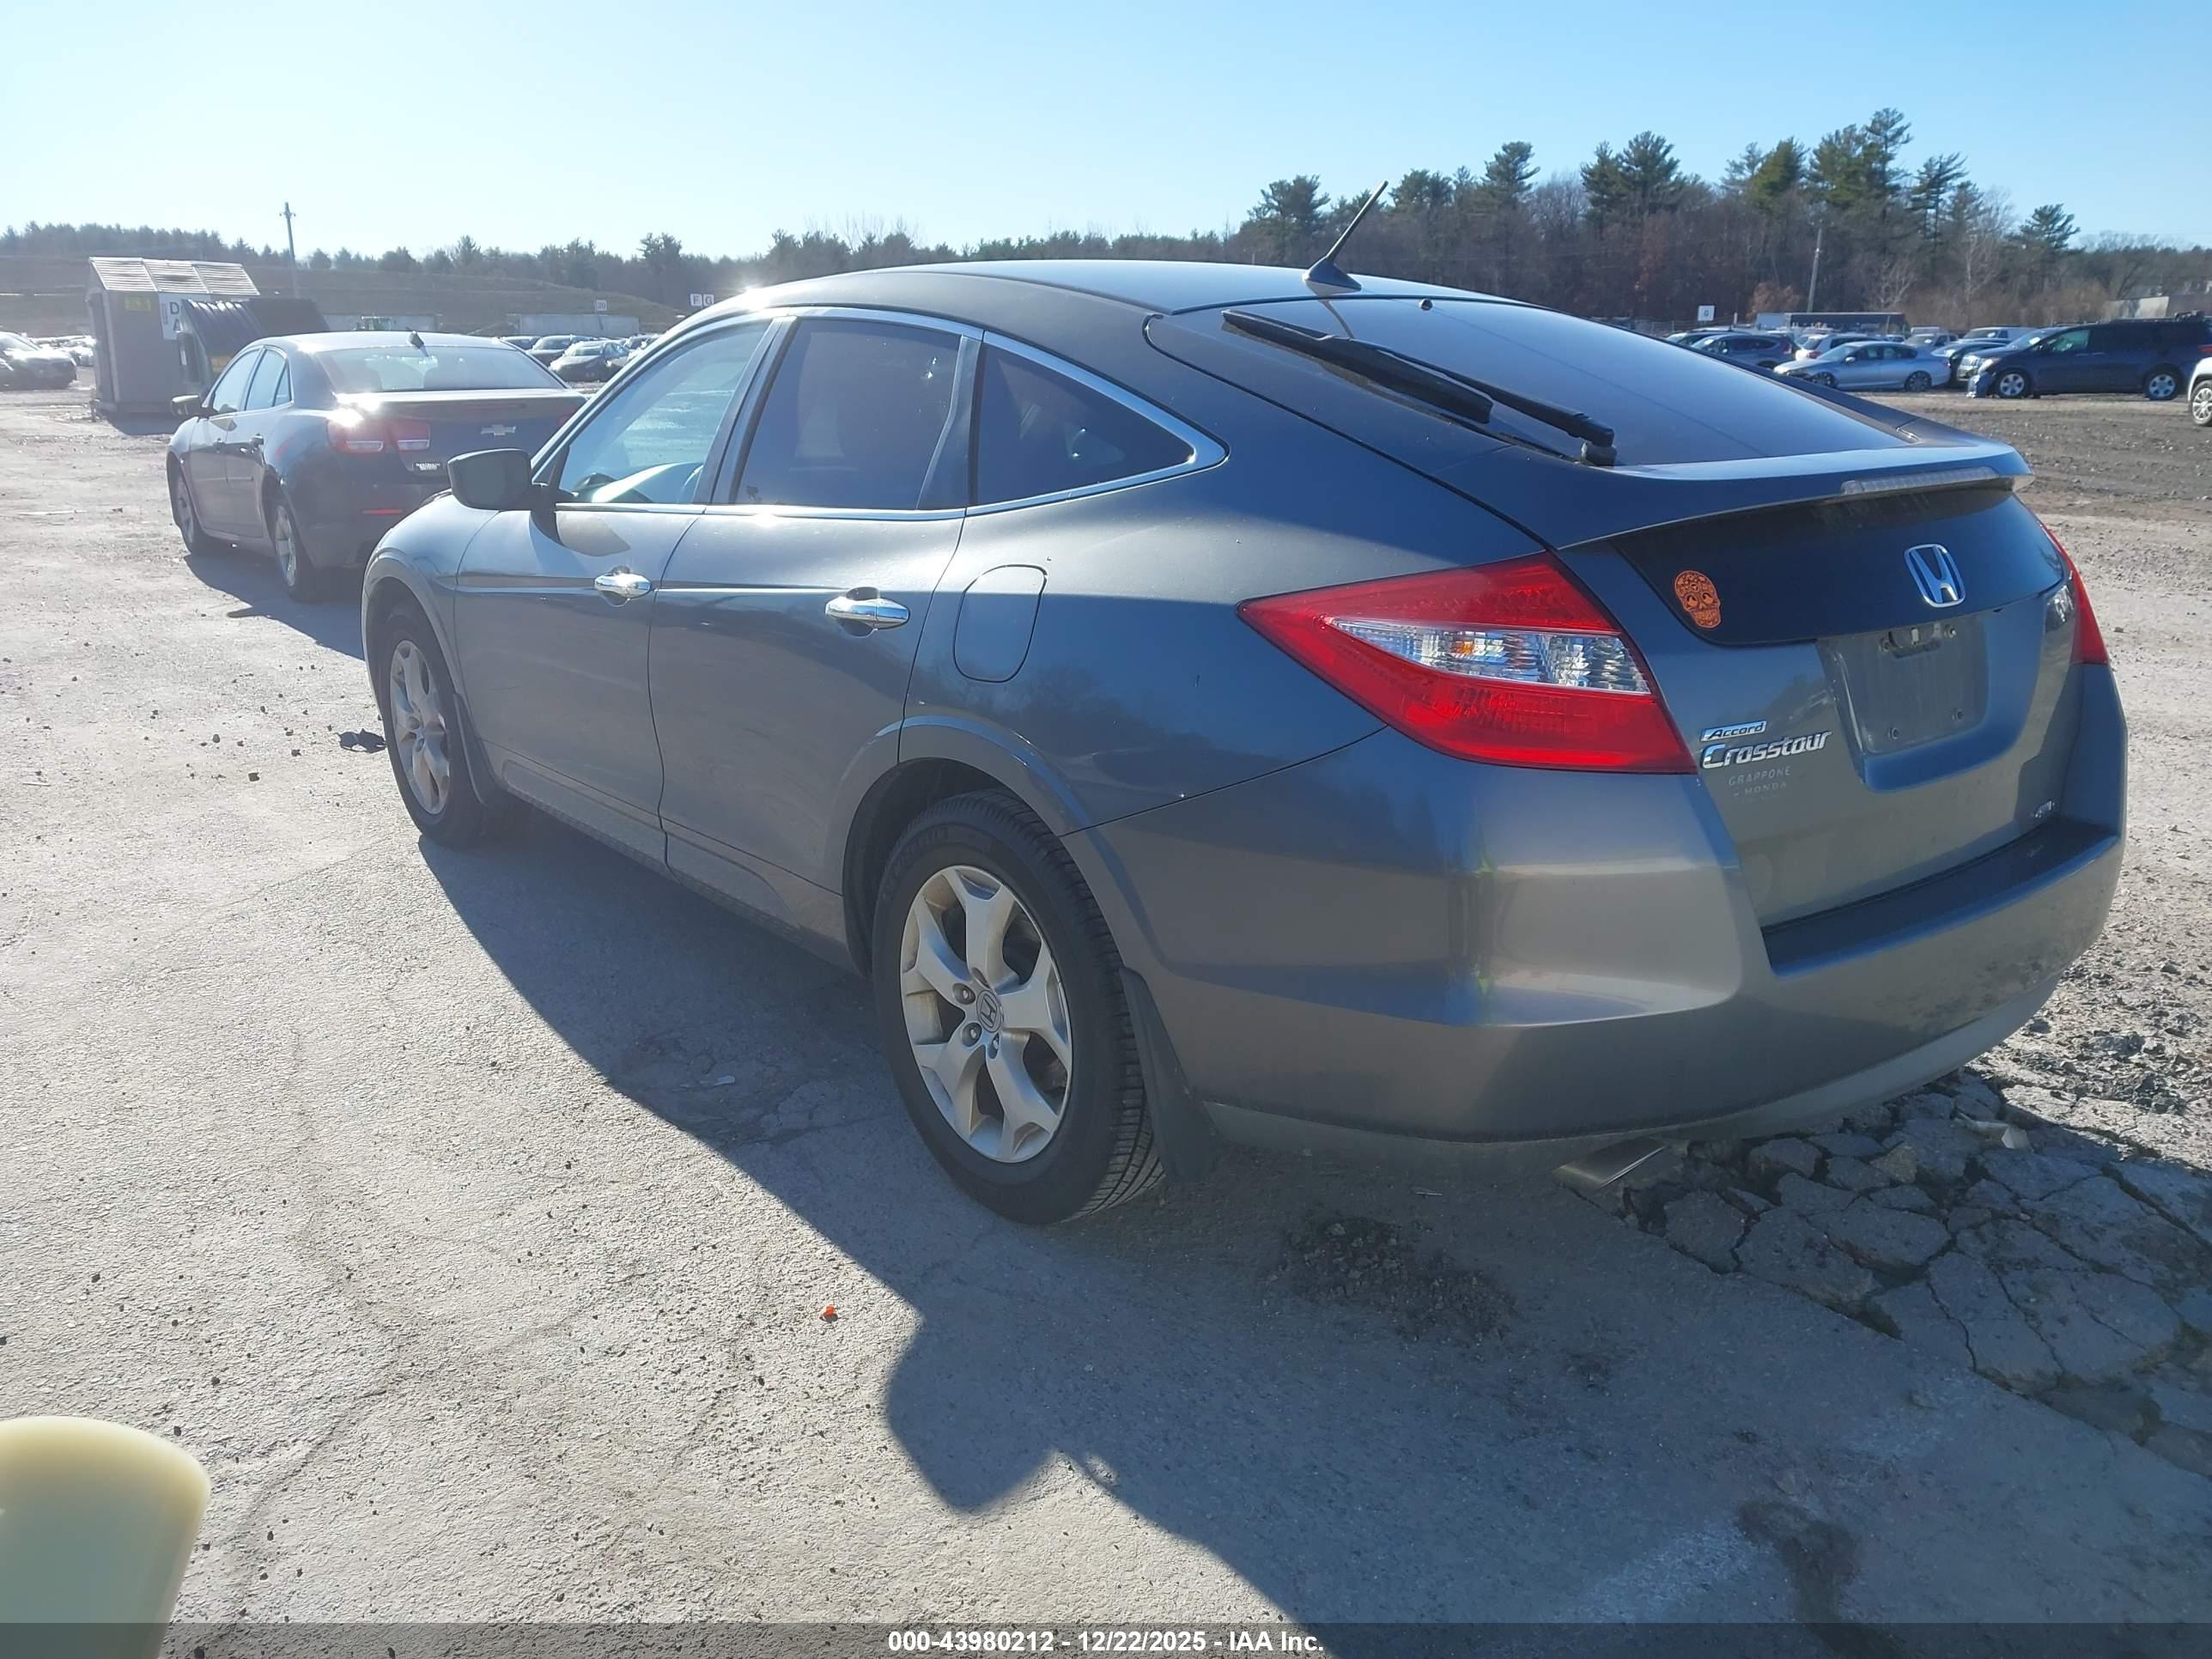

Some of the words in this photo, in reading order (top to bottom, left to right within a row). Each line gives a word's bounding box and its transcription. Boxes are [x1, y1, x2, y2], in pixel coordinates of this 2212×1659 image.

[1707, 721, 1765, 740] Accord
[1702, 732, 1832, 769] Crosstour
[1729, 765, 1791, 787] GRAPPONE
